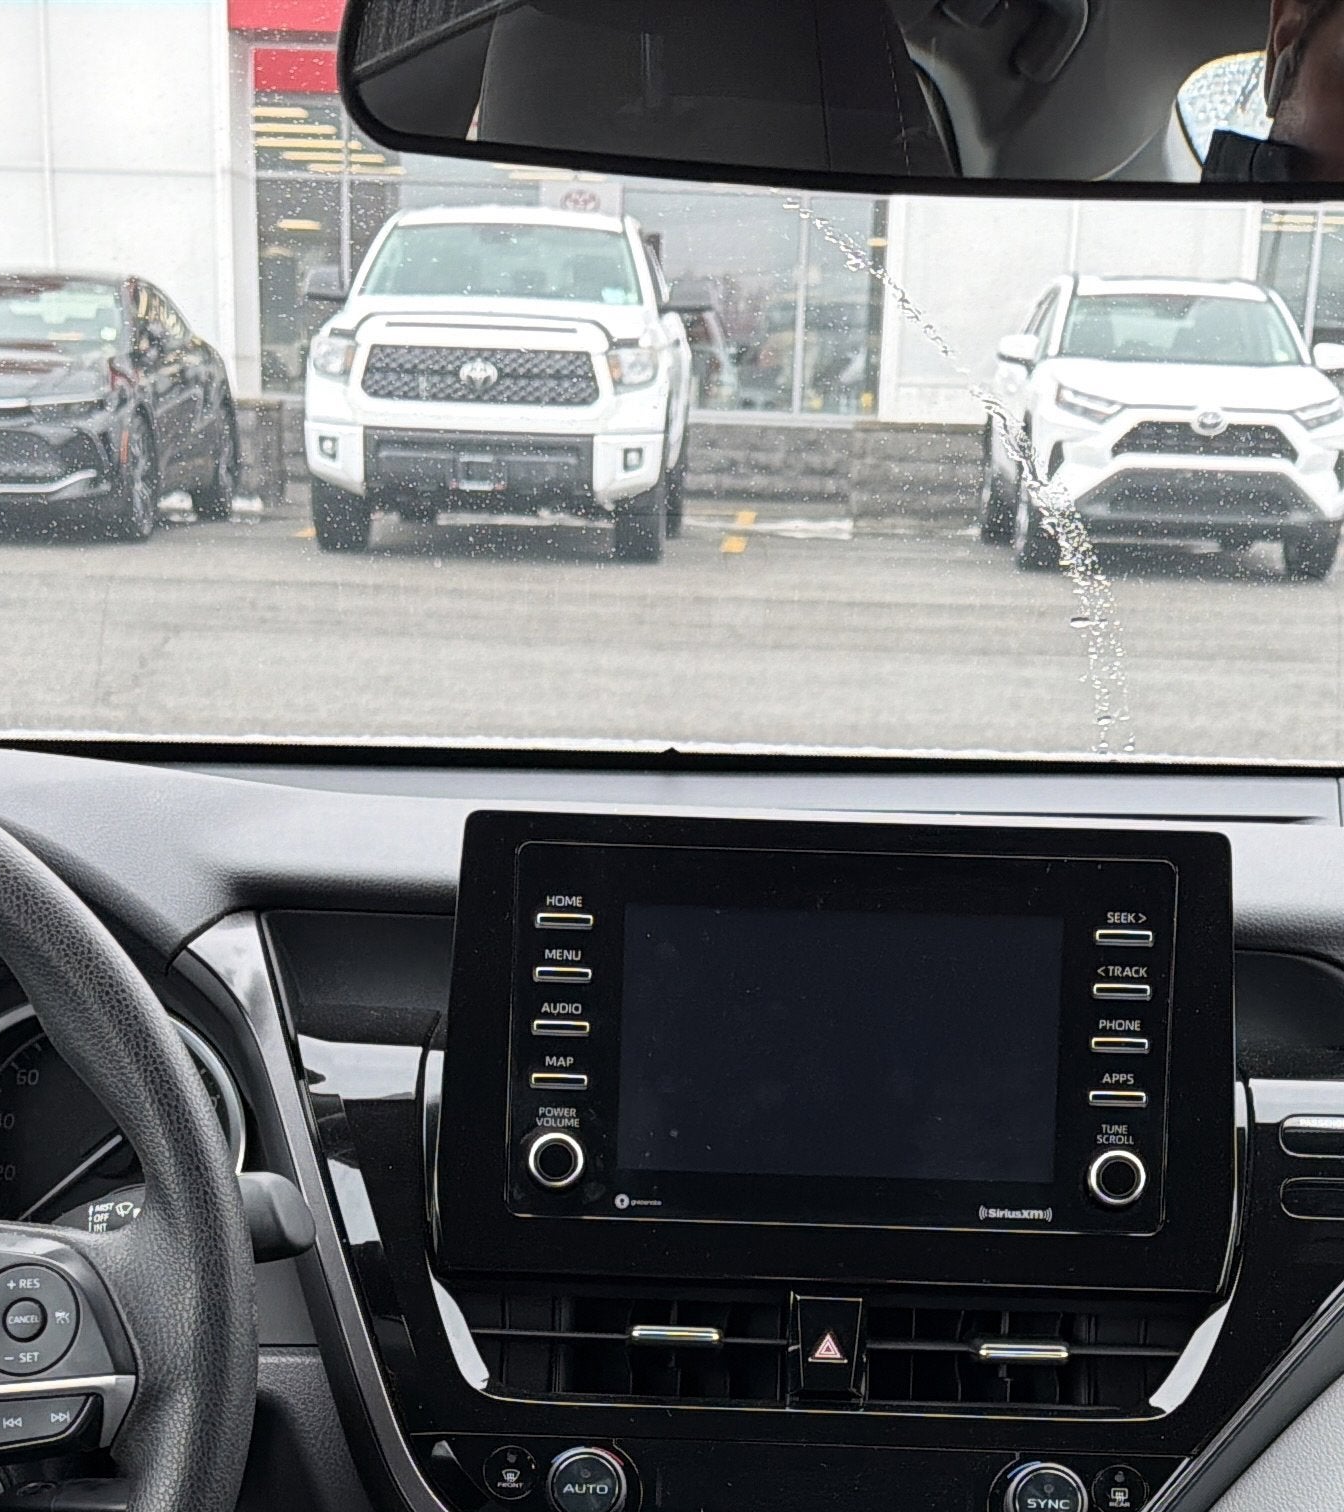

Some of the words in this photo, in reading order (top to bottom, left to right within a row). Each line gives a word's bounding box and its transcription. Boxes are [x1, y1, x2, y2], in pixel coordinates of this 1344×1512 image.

[545, 895, 583, 907] HOME
[544, 949, 582, 961] MENU
[541, 1002, 582, 1014] AUDIO
[1098, 1019, 1142, 1031] PHONE
[545, 1056, 575, 1068] MAP
[15, 1068, 40, 1086] 60
[1102, 1073, 1135, 1085] APPS
[538, 1106, 577, 1117] POWER
[536, 1117, 580, 1128] VOLUME
[1101, 1123, 1128, 1134] TUNE
[1096, 1134, 1135, 1145] SCROLL
[18, 1278, 41, 1289] RES
[8, 1314, 40, 1325] CANCEL
[18, 1352, 41, 1363] SET
[562, 1483, 609, 1495] AUTO
[1026, 1499, 1071, 1510] SYNC
